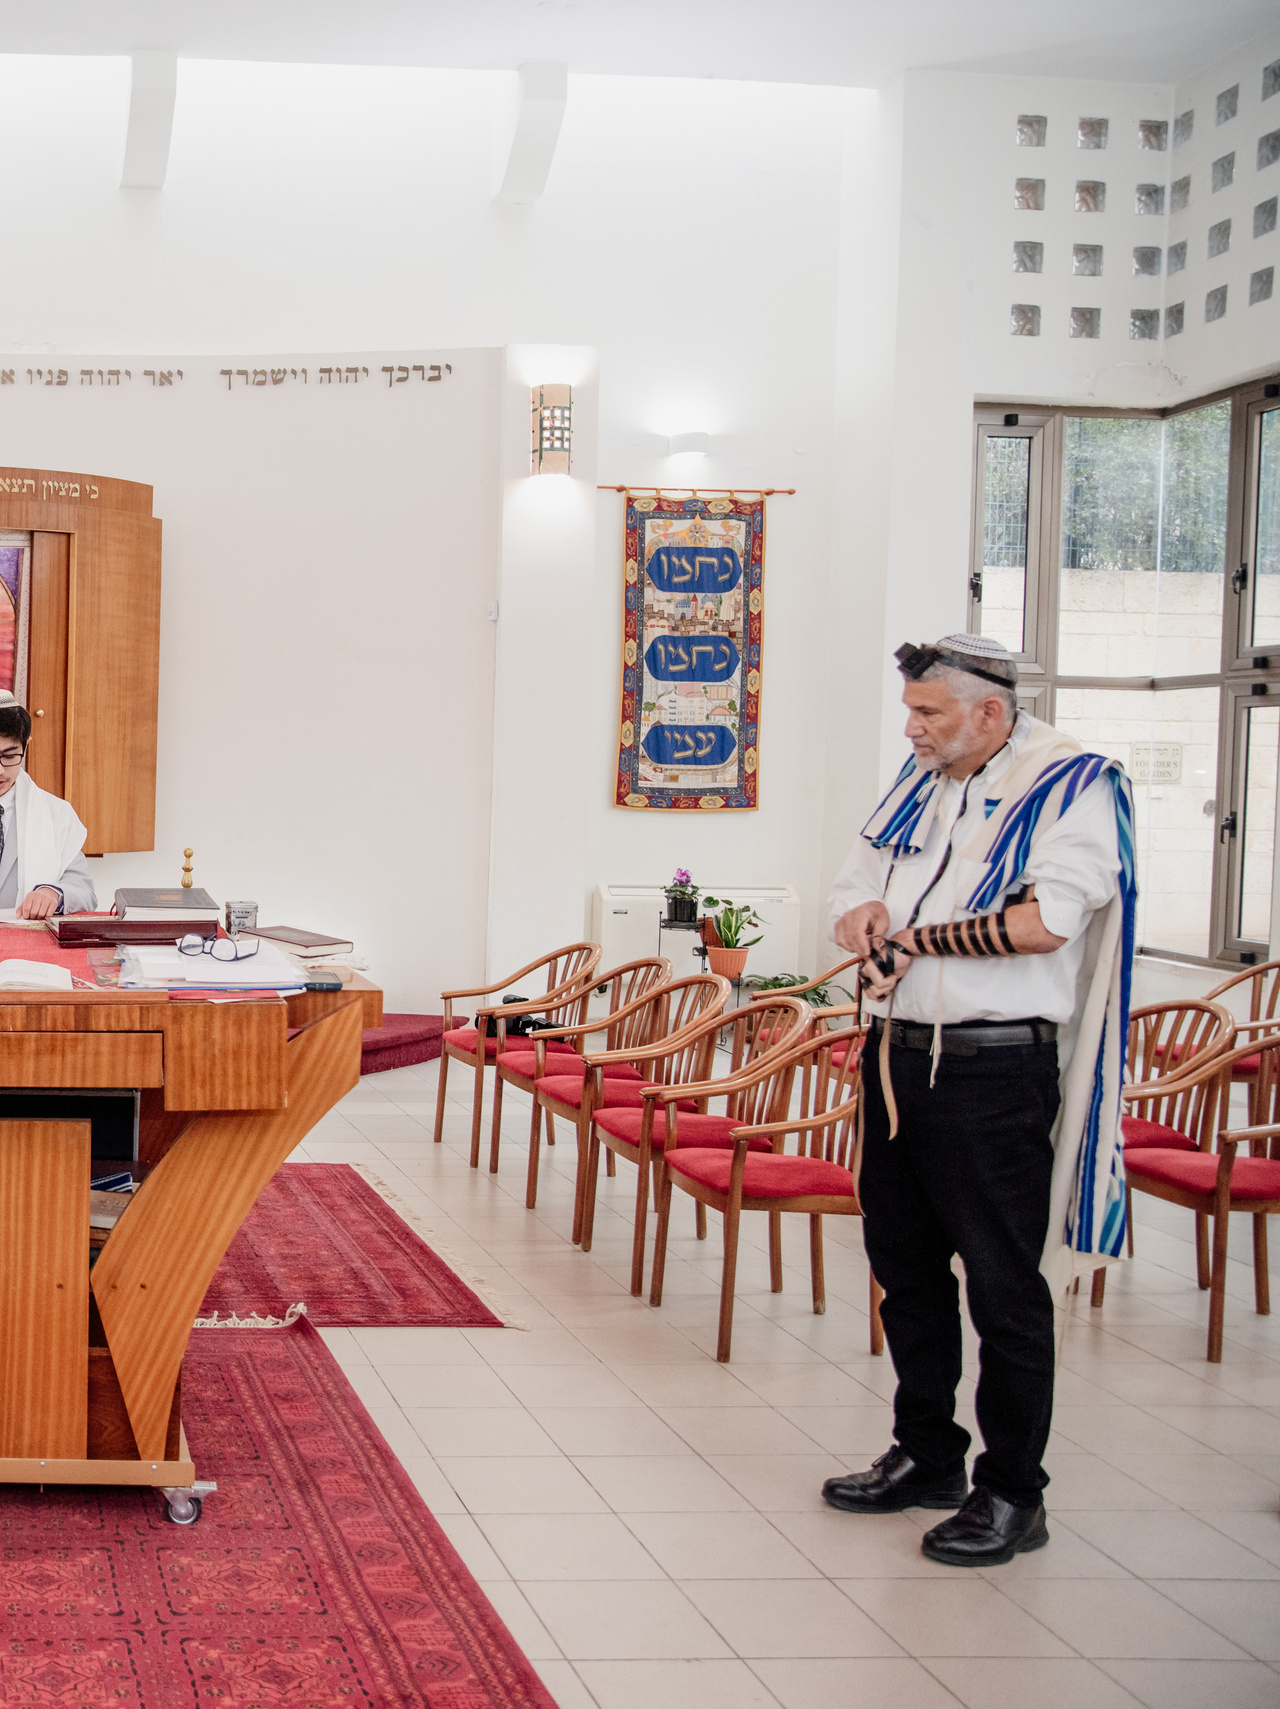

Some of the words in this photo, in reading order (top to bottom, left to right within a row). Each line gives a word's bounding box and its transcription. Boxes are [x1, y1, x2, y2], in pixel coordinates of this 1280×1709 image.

[27, 368, 69, 387] פניו
[80, 369, 132, 386] יהוה
[143, 368, 184, 387] יאר
[220, 368, 308, 391] וישמרך
[319, 366, 369, 385] יהוה
[381, 363, 453, 389] יברכך
[41, 480, 81, 500] מציון
[85, 483, 100, 500] כי
[660, 553, 734, 583] נחמו
[657, 643, 731, 672] נחמו
[664, 729, 716, 760] עמי
[1135, 760, 1178, 769] FODER'S
